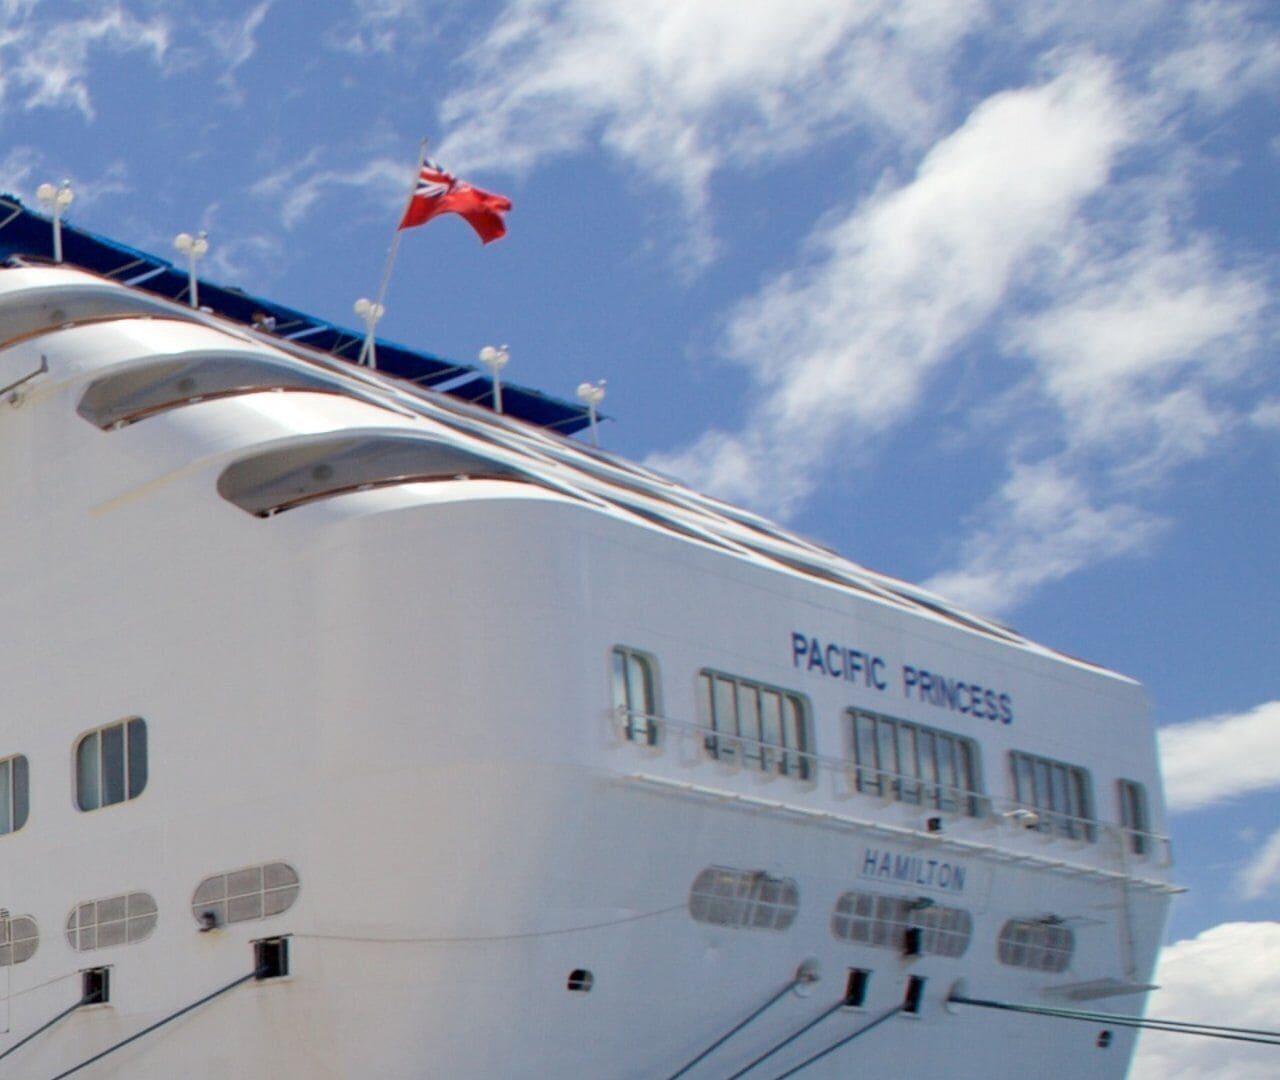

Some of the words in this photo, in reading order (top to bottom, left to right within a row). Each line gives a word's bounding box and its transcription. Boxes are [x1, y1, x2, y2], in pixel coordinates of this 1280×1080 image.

[792, 633, 886, 690] PACIFIC
[903, 666, 1013, 724] PRINCESS
[863, 849, 966, 890] HAMILTON
